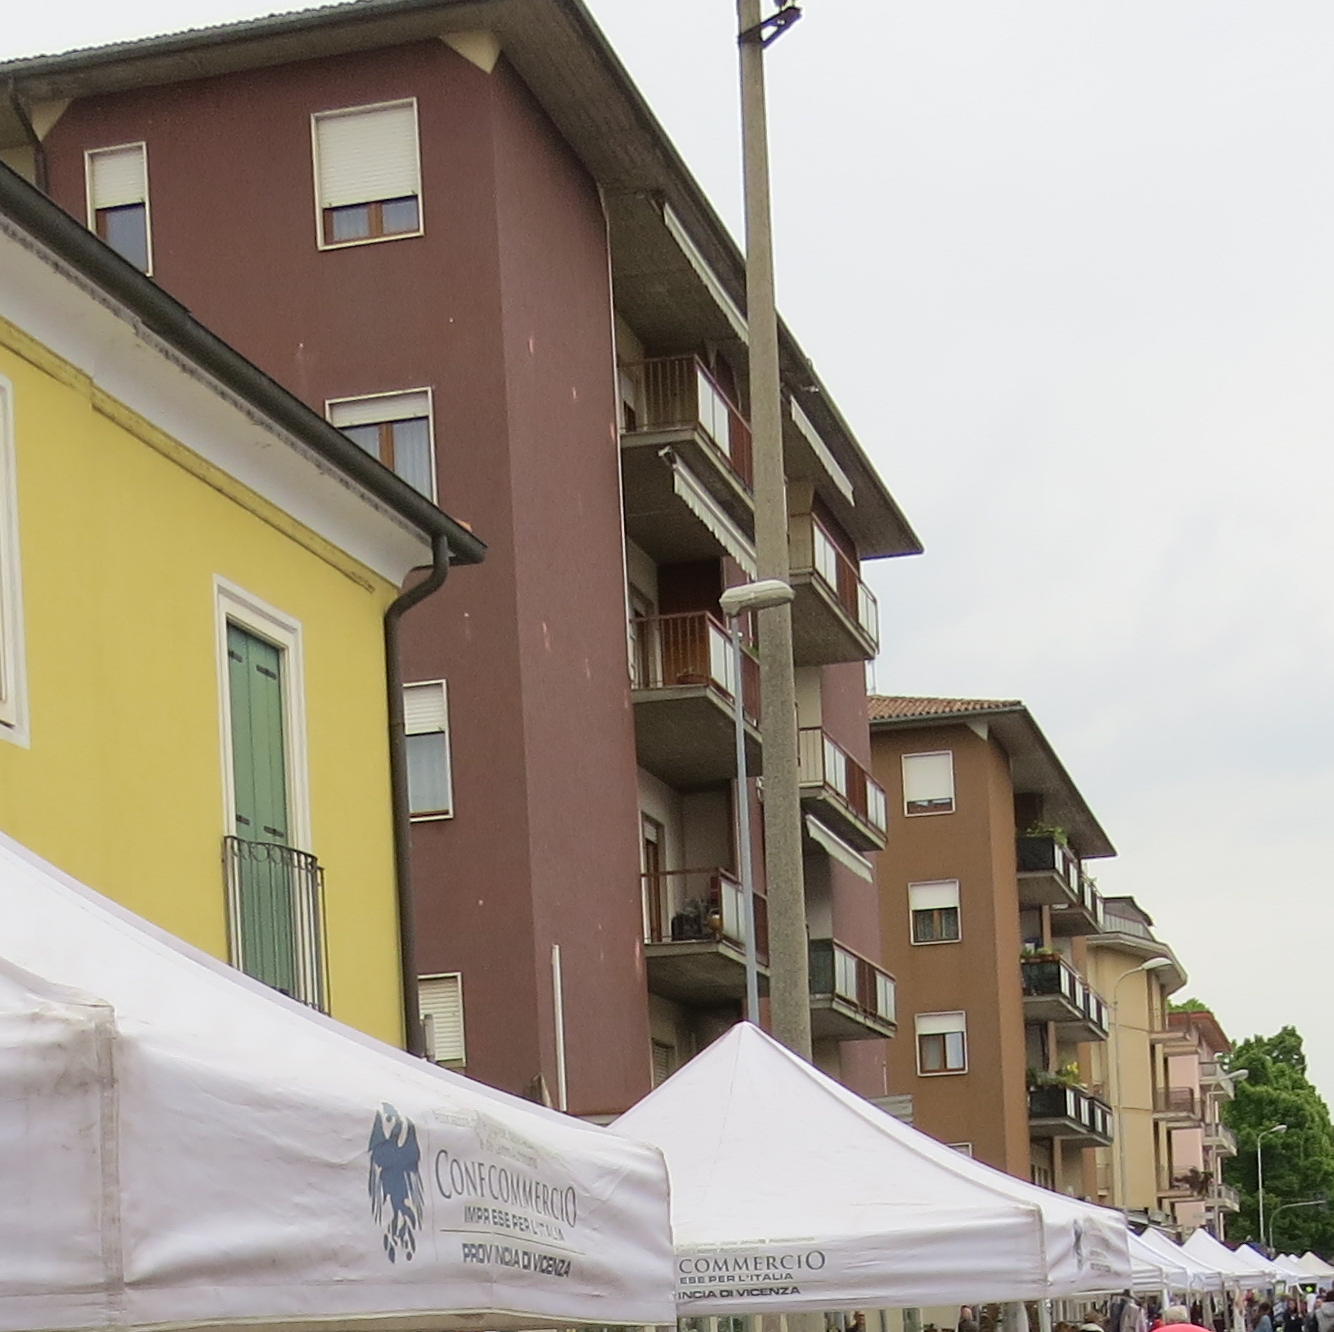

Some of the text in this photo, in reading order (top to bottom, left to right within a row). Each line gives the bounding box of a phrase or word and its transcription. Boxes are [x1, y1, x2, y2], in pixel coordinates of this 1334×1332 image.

[462, 1243, 520, 1270] PROVNCIA
[678, 1250, 826, 1274] COMMERCIO
[708, 1274, 736, 1283] PER
[739, 1273, 794, 1282] L'ITALIA
[677, 1286, 801, 1300] INCIA DI VICENZA
